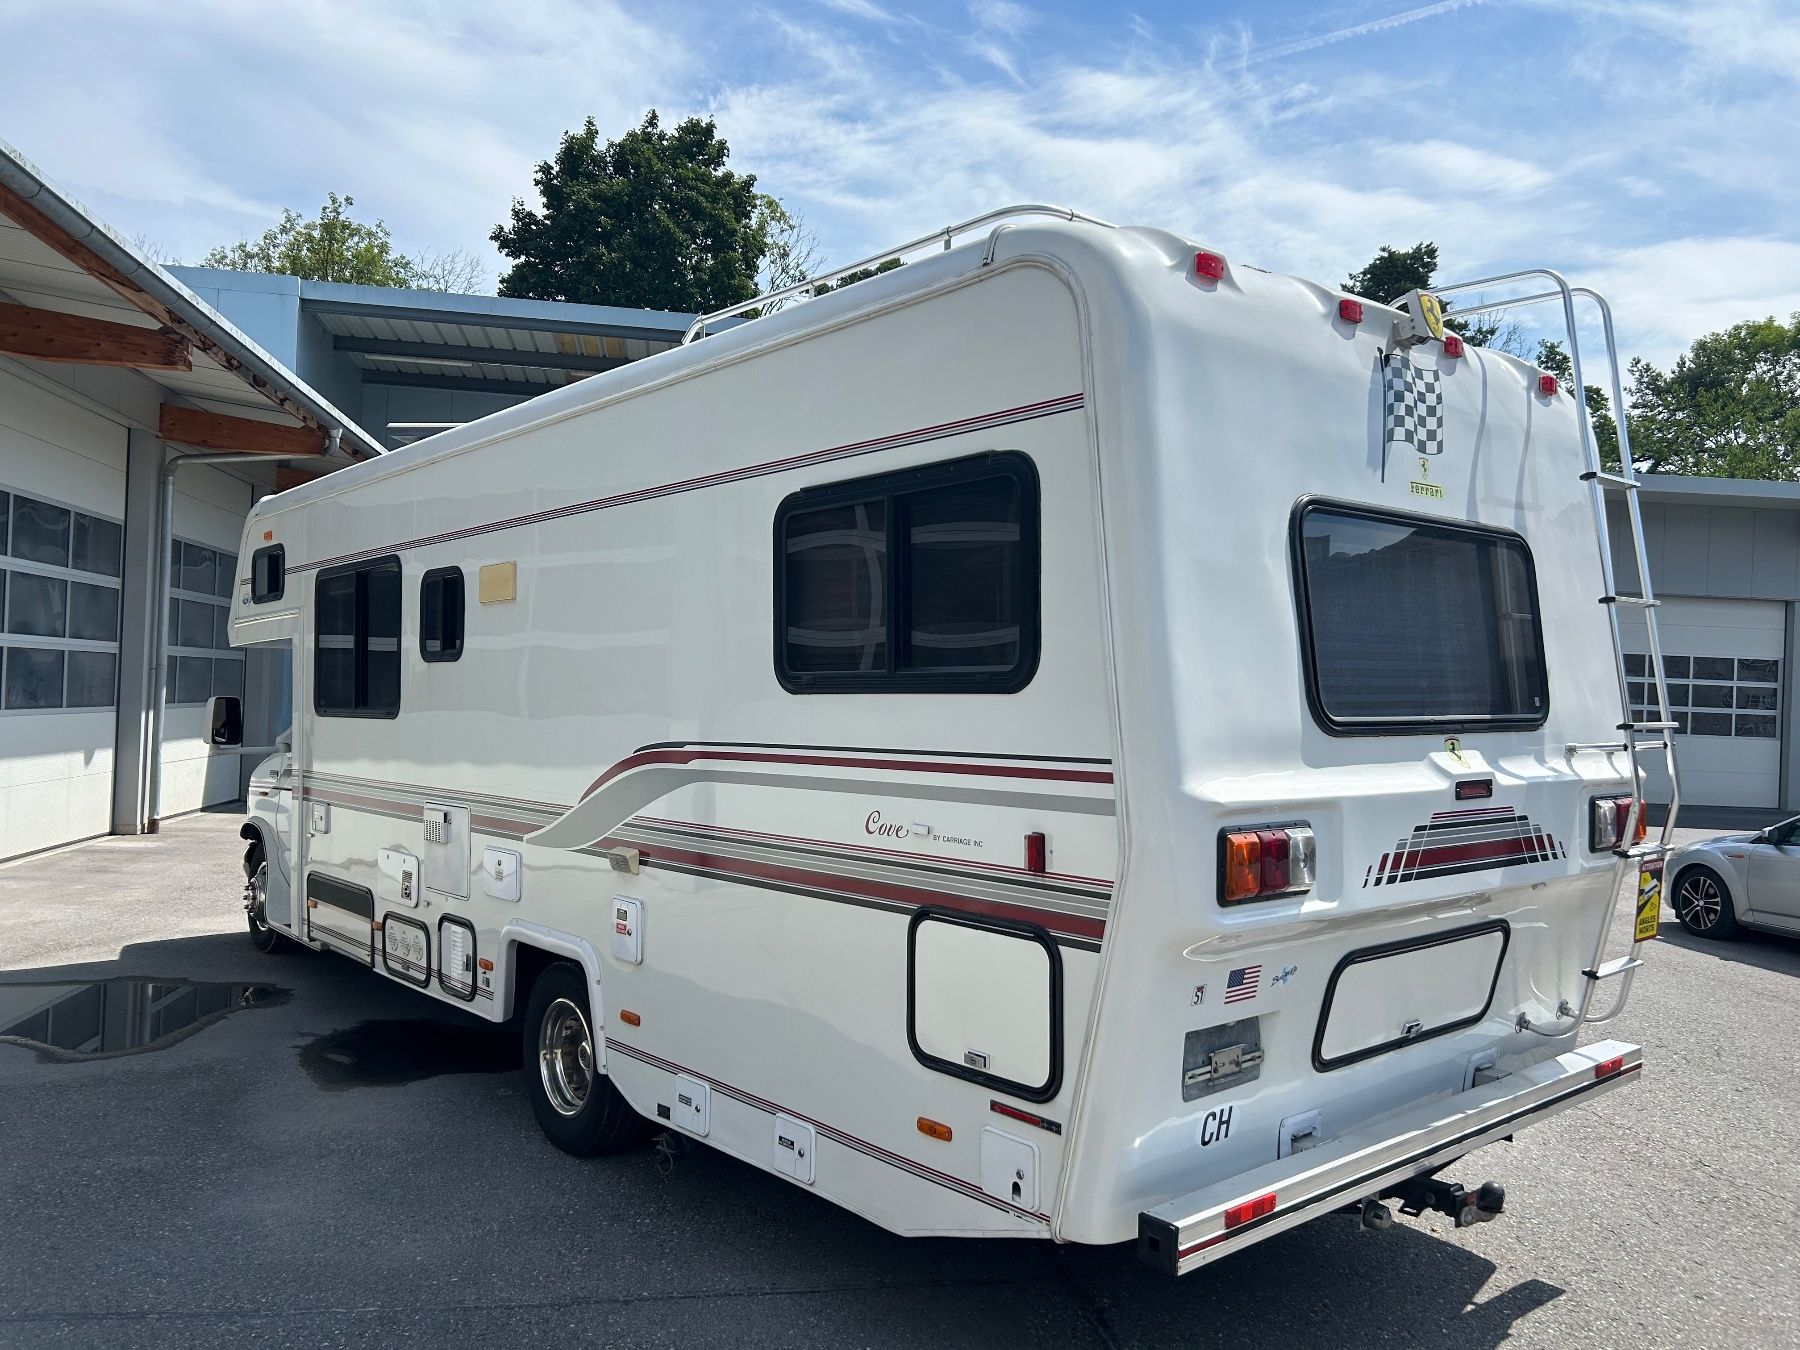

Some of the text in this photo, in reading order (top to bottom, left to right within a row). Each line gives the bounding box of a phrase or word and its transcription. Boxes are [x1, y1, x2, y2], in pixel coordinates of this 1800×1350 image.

[1410, 481, 1443, 498] Ferrari
[864, 810, 909, 838] Cove
[942, 835, 972, 846] CARRIAGE
[1639, 914, 1656, 926] ANGLES
[1638, 923, 1655, 935] MORTS
[1200, 1105, 1233, 1147] CH
